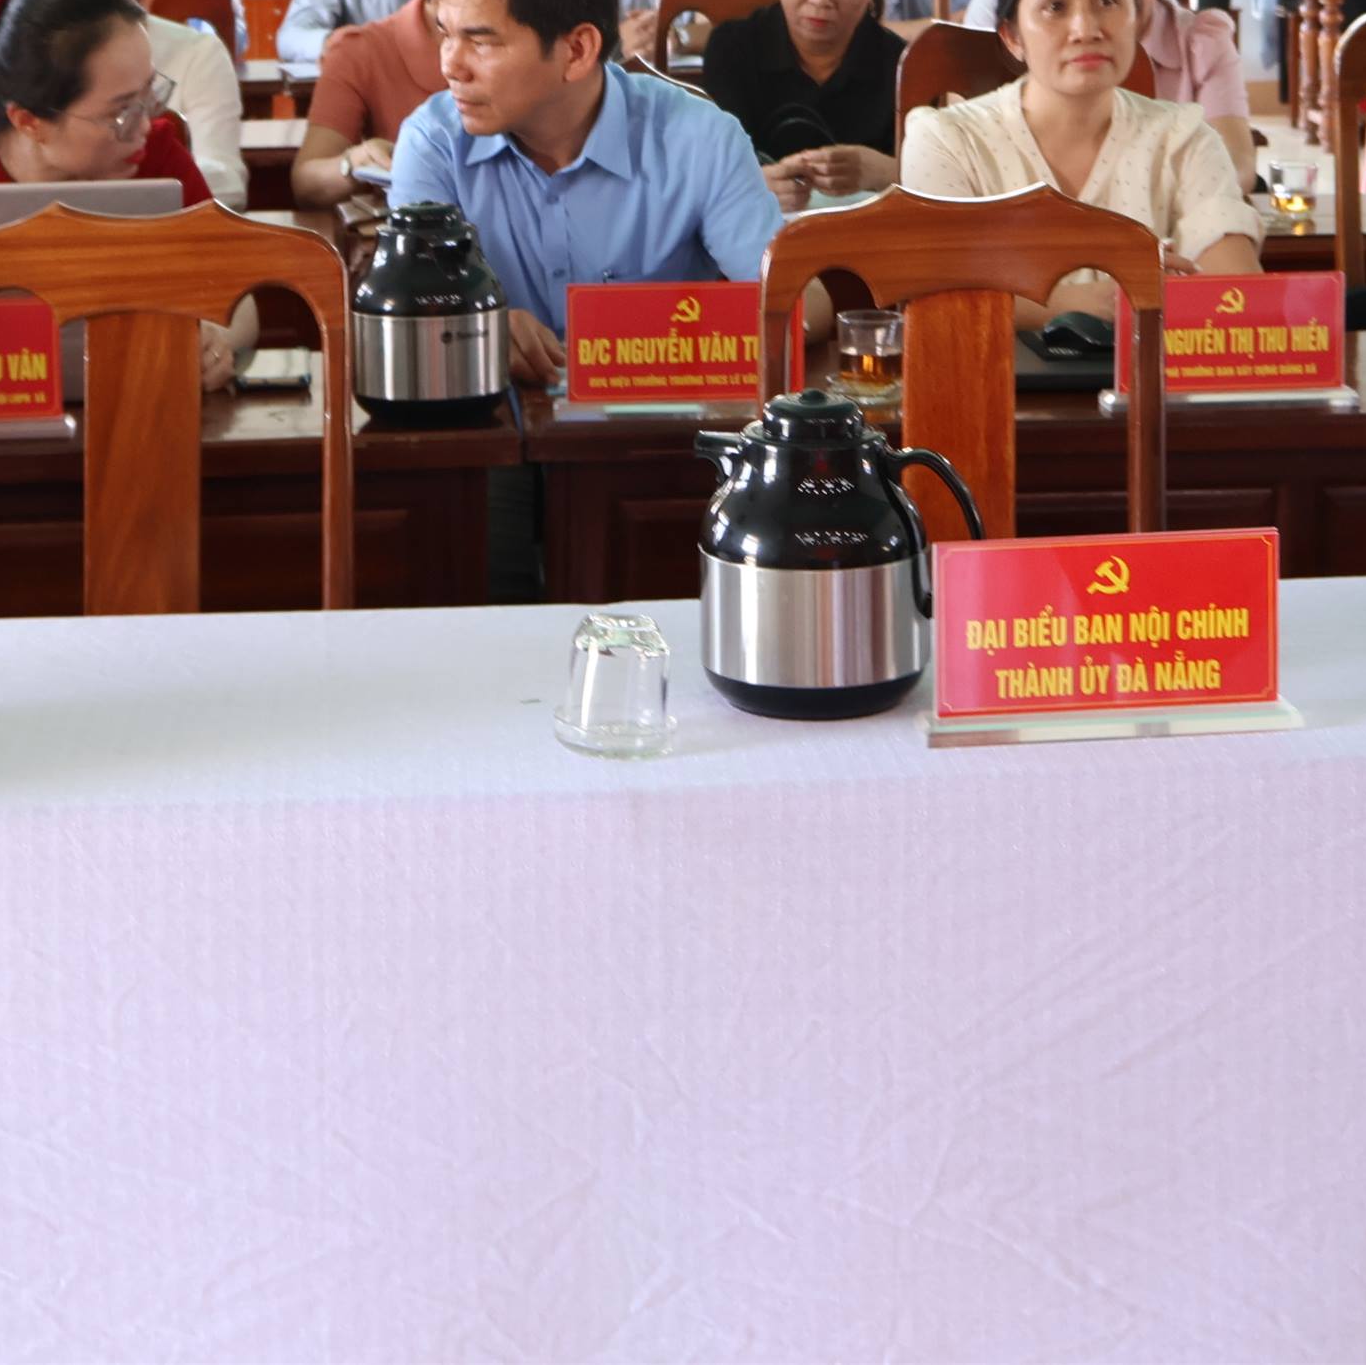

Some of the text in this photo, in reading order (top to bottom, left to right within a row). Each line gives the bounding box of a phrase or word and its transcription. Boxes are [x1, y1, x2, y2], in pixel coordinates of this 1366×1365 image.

[578, 338, 611, 365] Đ/C
[616, 327, 694, 364] NGUYỄN
[698, 330, 737, 363] VĂN
[1229, 327, 1254, 359] THỊ
[1258, 326, 1288, 353] THU
[966, 603, 1249, 656] ĐẠI BIỂU BAN NỘI CHÍNH
[995, 650, 1221, 699] THÀNH ỦY ĐÀ NẴNG
